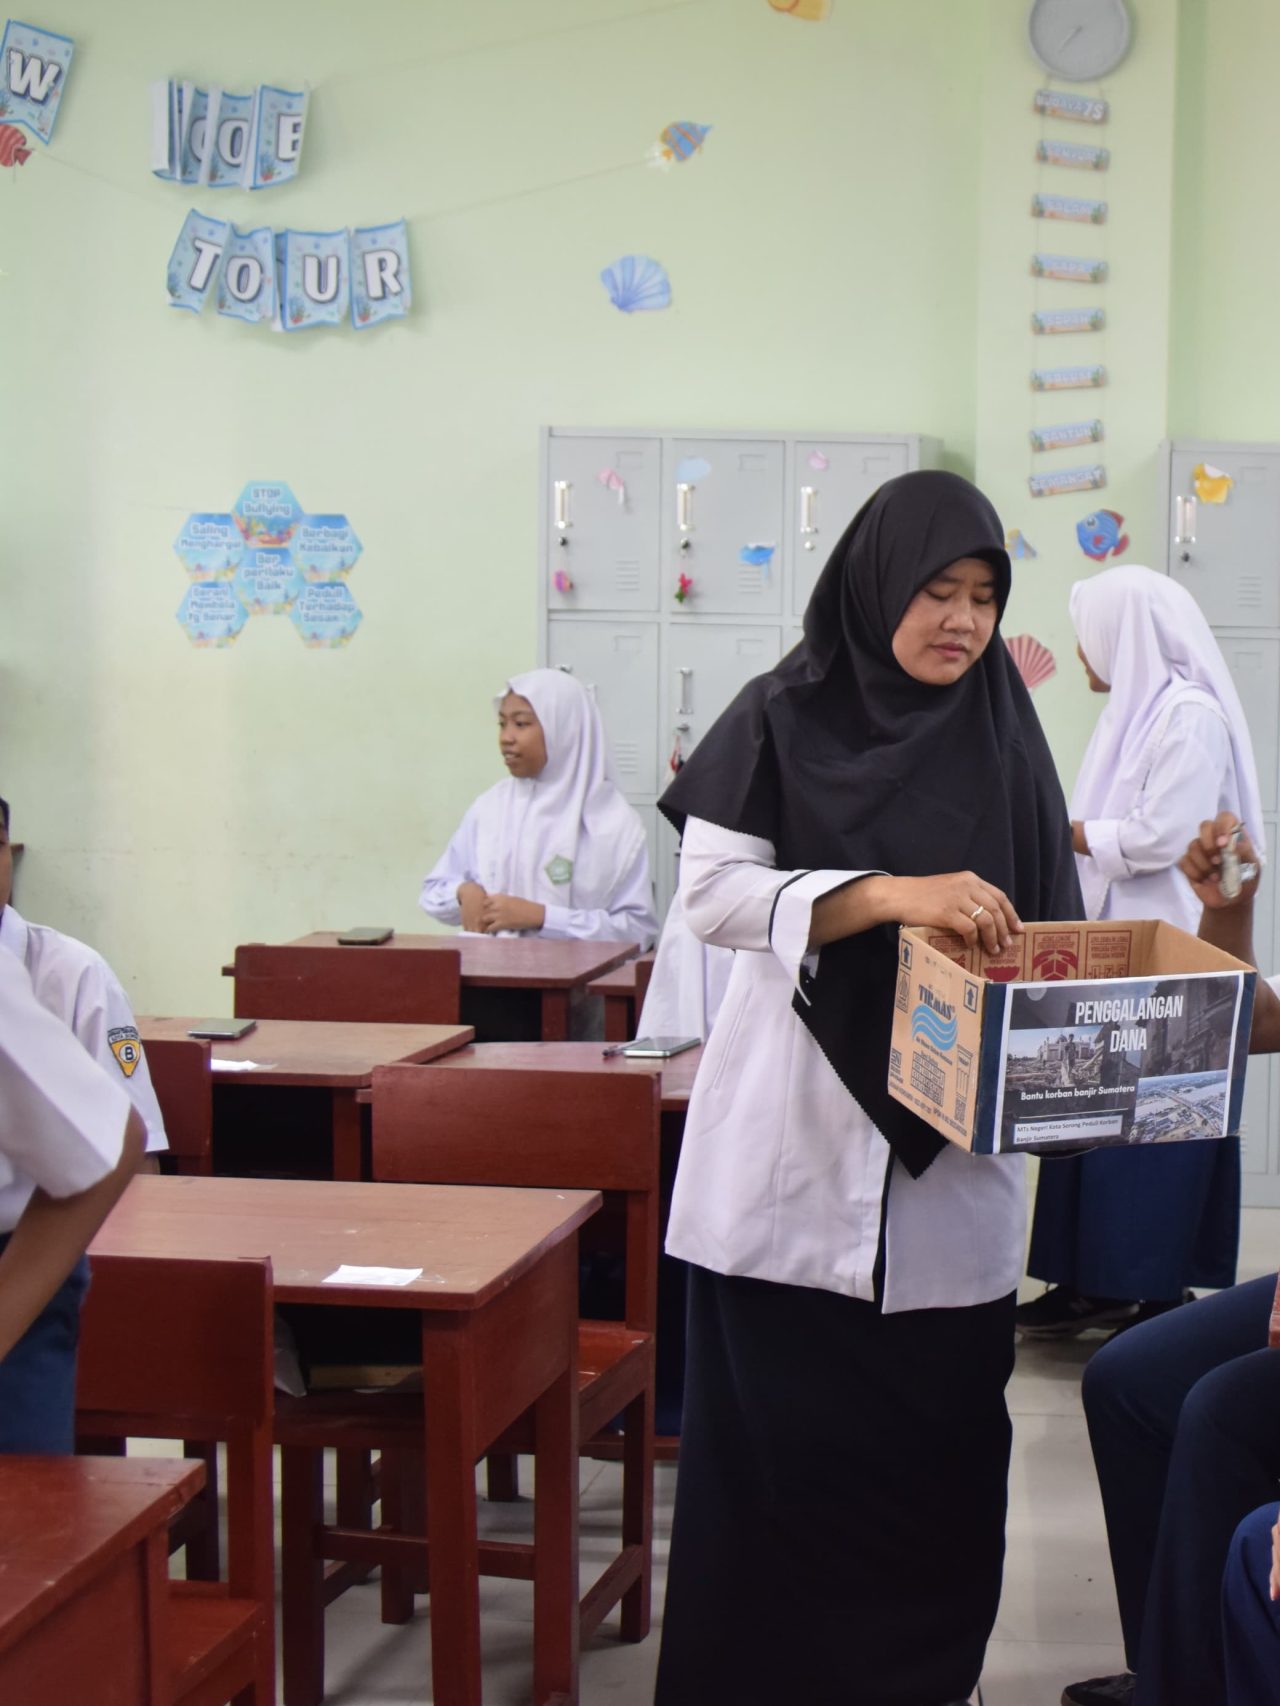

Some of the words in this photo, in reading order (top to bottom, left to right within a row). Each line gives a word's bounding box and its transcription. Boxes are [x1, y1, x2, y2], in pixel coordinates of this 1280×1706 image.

[1083, 102, 1105, 120] 7S
[253, 489, 281, 498] STOP
[1074, 995, 1184, 1025] PENGGALANGAN
[1109, 1028, 1147, 1053] DANA
[125, 1046, 134, 1060] B
[1020, 1091, 1044, 1101] Bantu
[1045, 1089, 1073, 1099] korban
[1074, 1087, 1097, 1098] banjir
[1098, 1085, 1136, 1095] Sumatera
